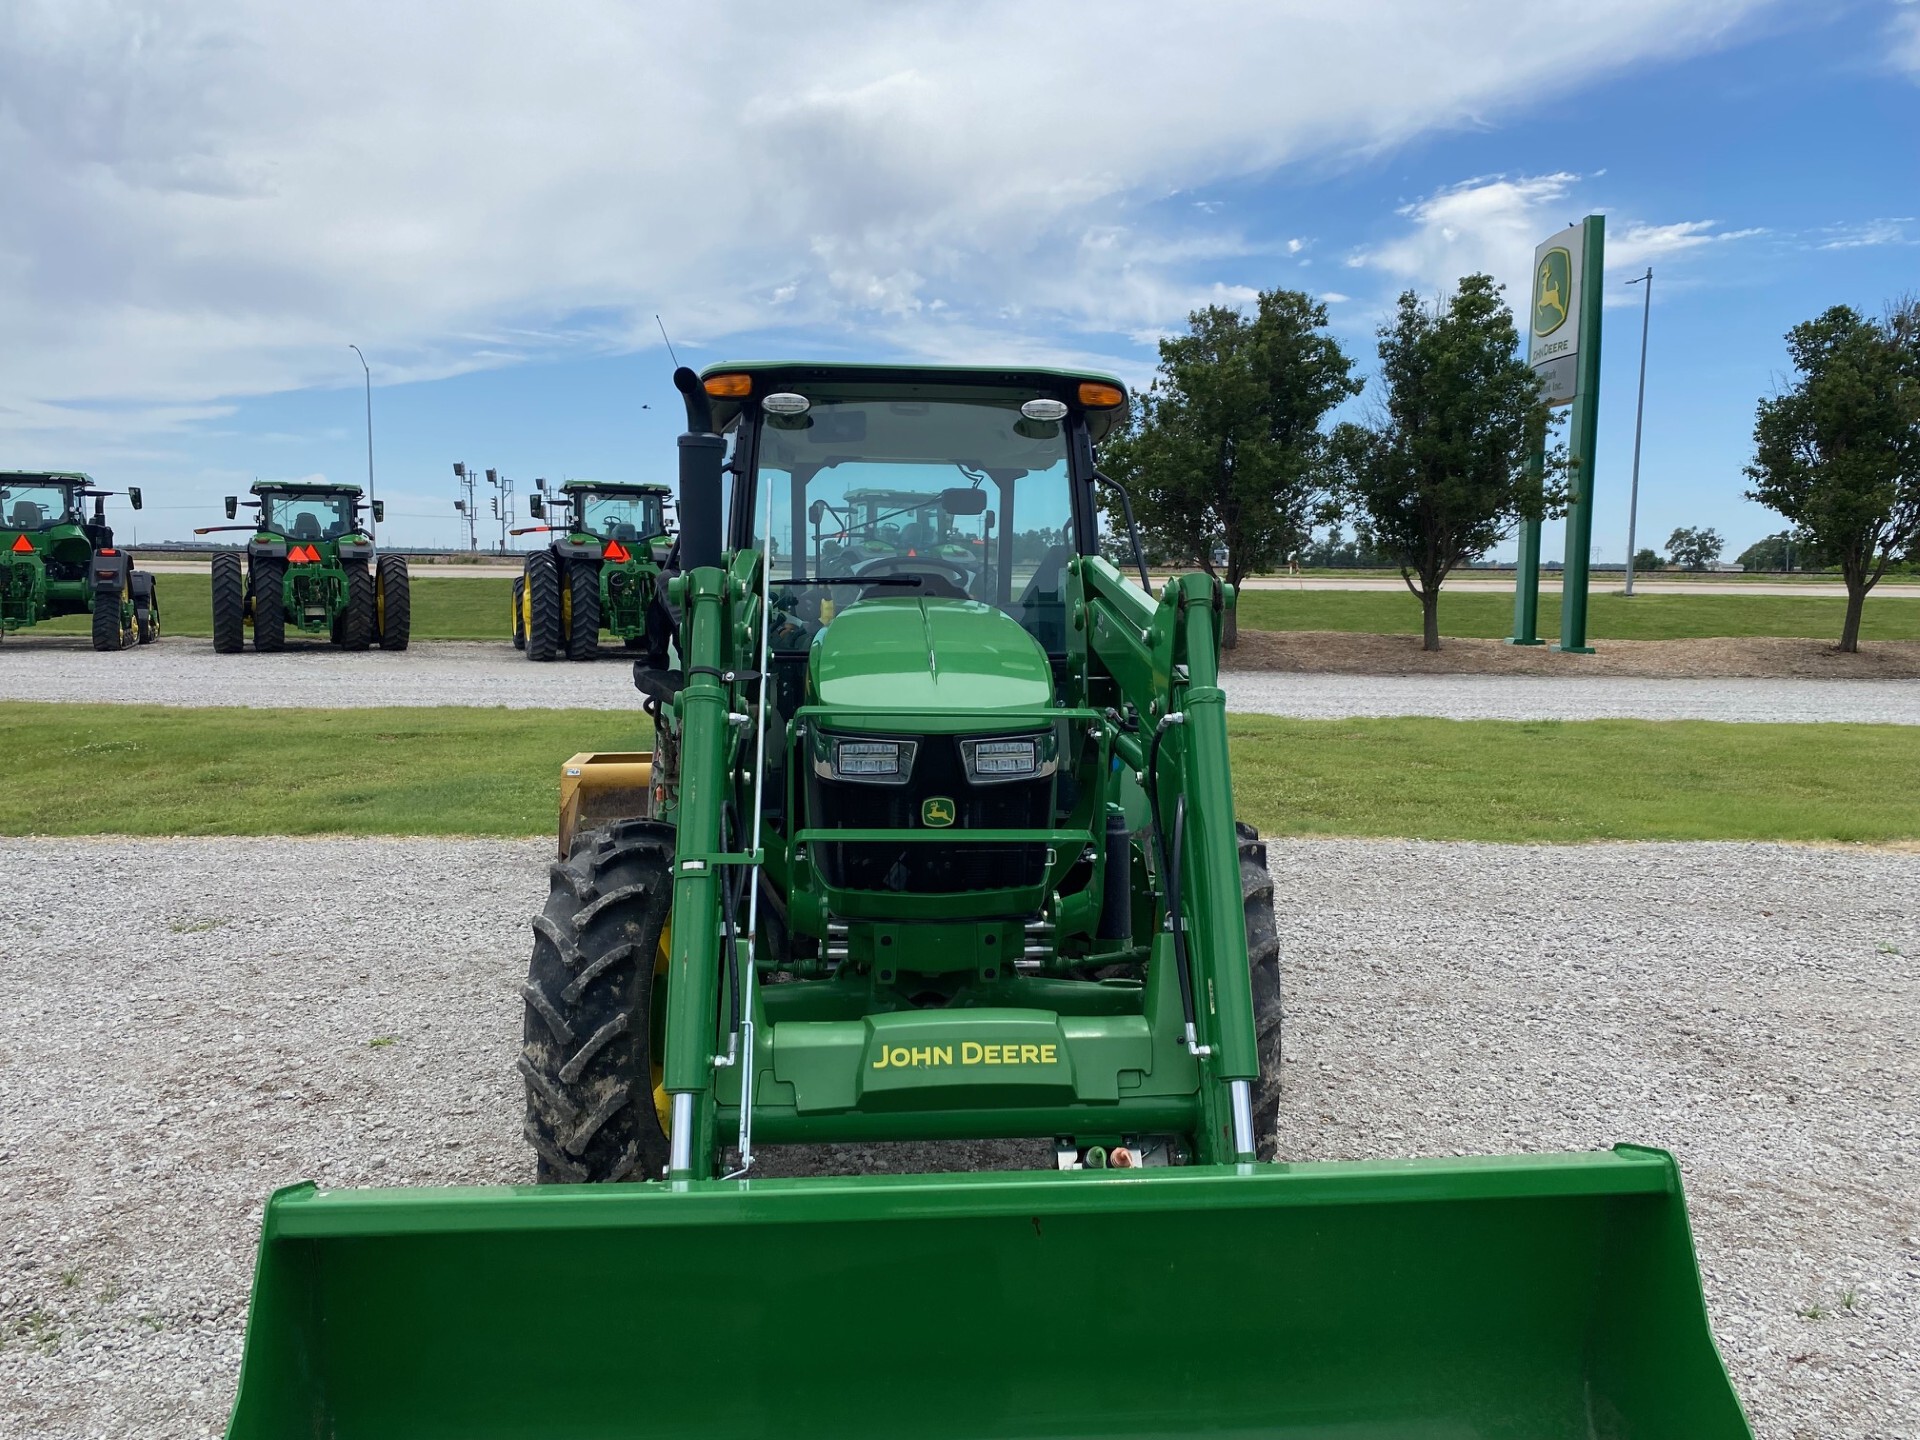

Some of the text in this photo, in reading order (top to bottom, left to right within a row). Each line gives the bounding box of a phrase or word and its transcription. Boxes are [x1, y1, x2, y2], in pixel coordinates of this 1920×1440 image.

[1544, 340, 1568, 355] DEERE
[873, 1041, 1058, 1069] JOHN DEERE
